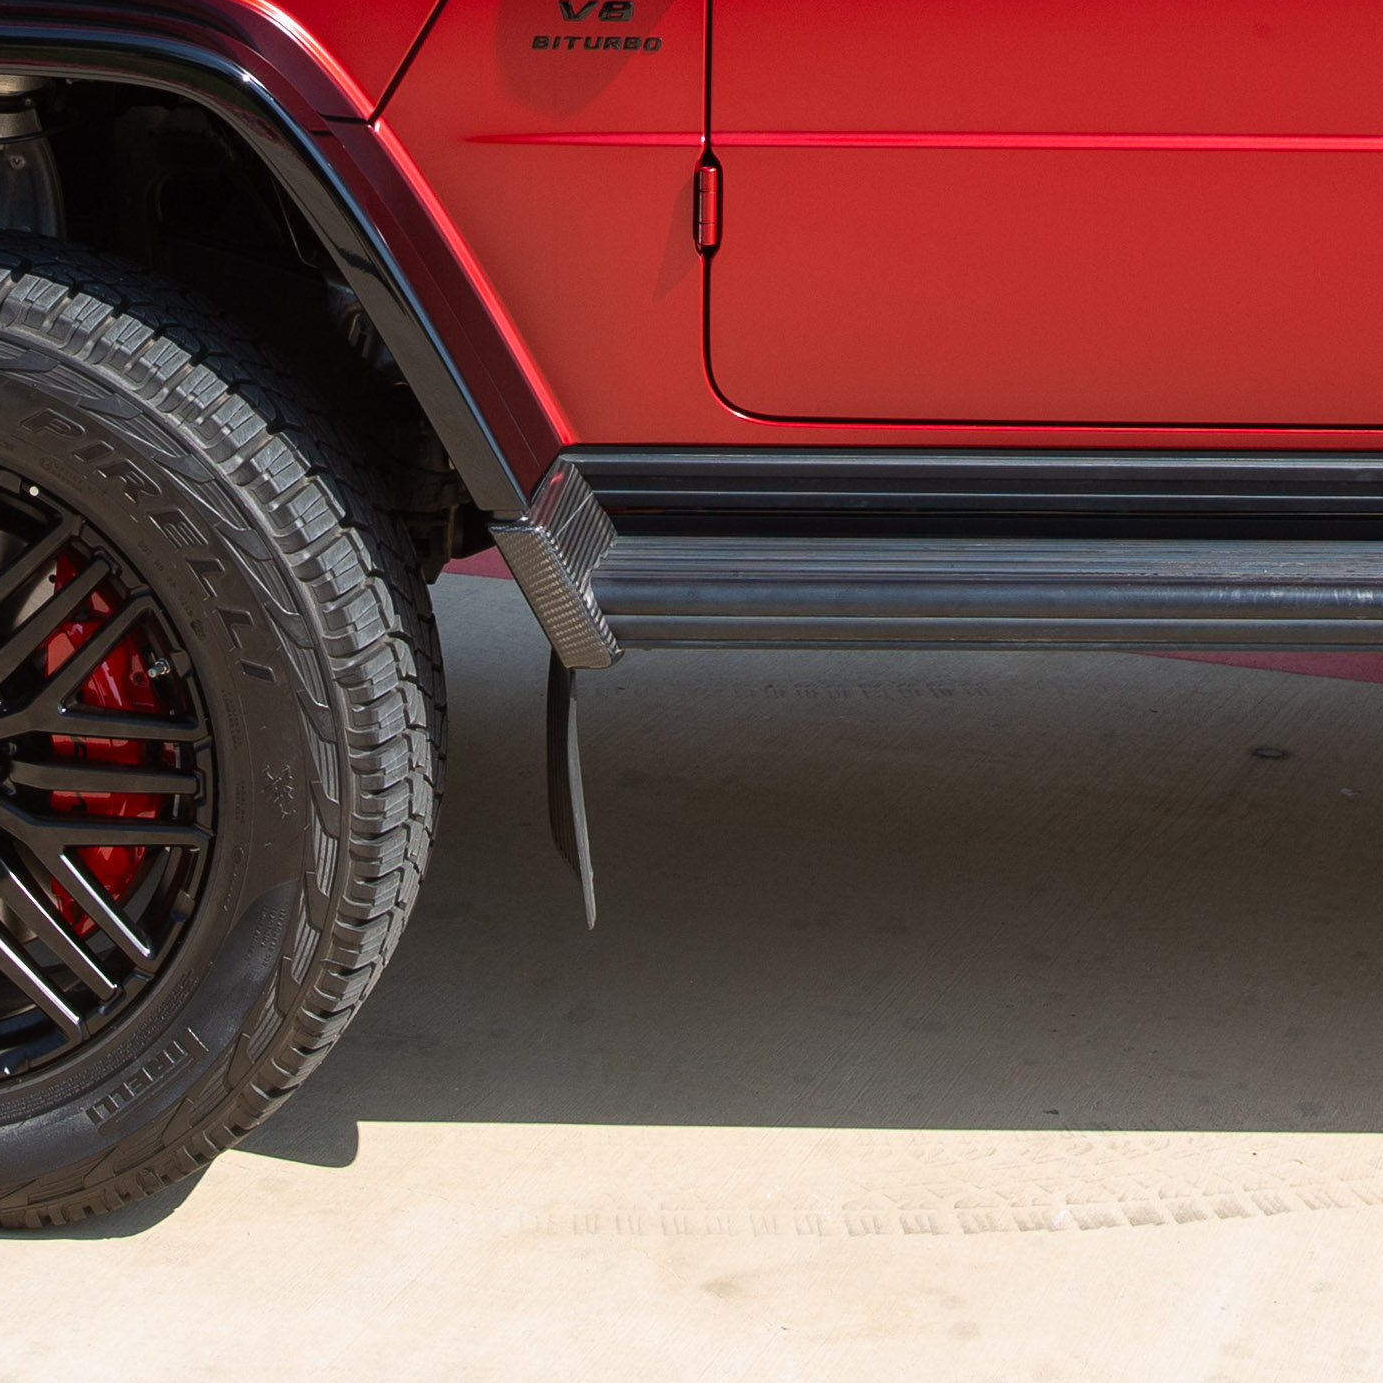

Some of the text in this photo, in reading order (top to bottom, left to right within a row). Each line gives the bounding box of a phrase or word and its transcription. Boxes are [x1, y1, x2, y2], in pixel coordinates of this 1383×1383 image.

[558, 0, 635, 22] V8
[531, 34, 663, 52] BITURBO
[17, 407, 278, 684] PIRELLI
